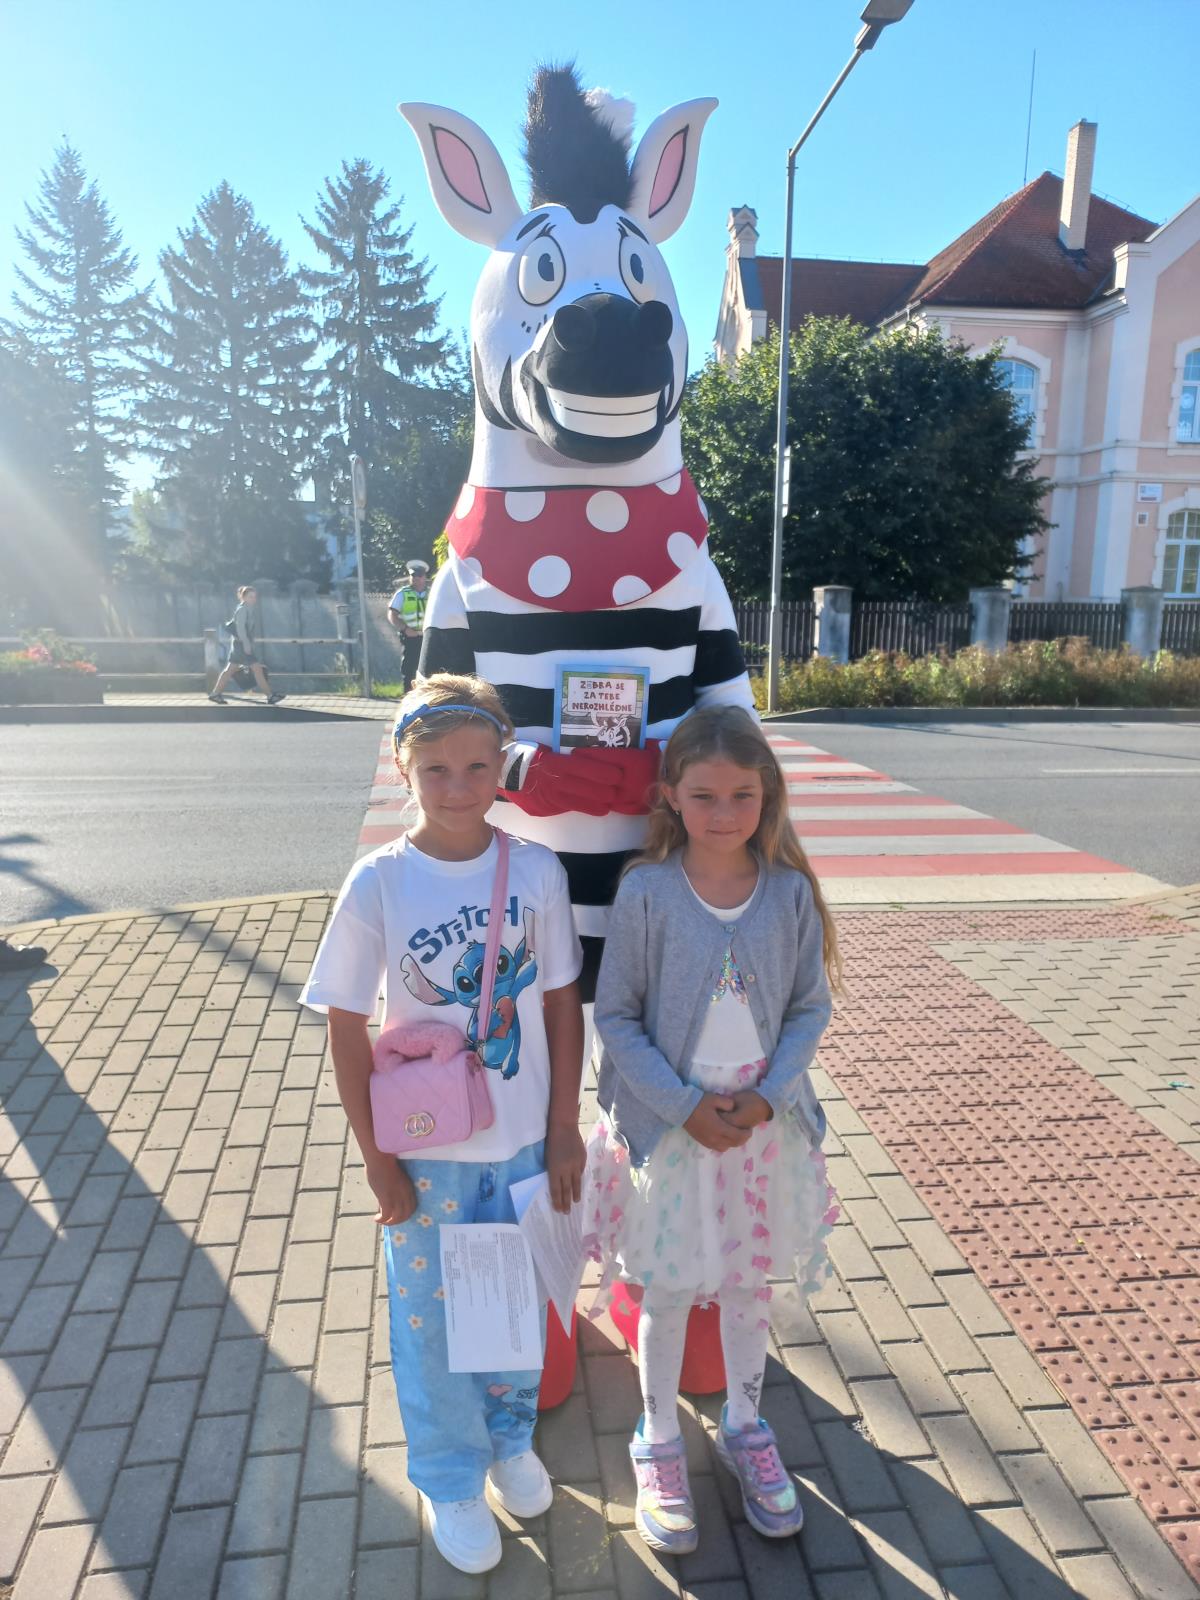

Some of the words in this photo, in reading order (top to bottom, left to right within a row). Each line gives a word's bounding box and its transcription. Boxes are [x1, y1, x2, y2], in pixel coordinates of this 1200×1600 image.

[584, 691, 596, 699] ZA
[599, 692, 620, 700] TEBE
[572, 701, 632, 712] NEROZHLÉDNE
